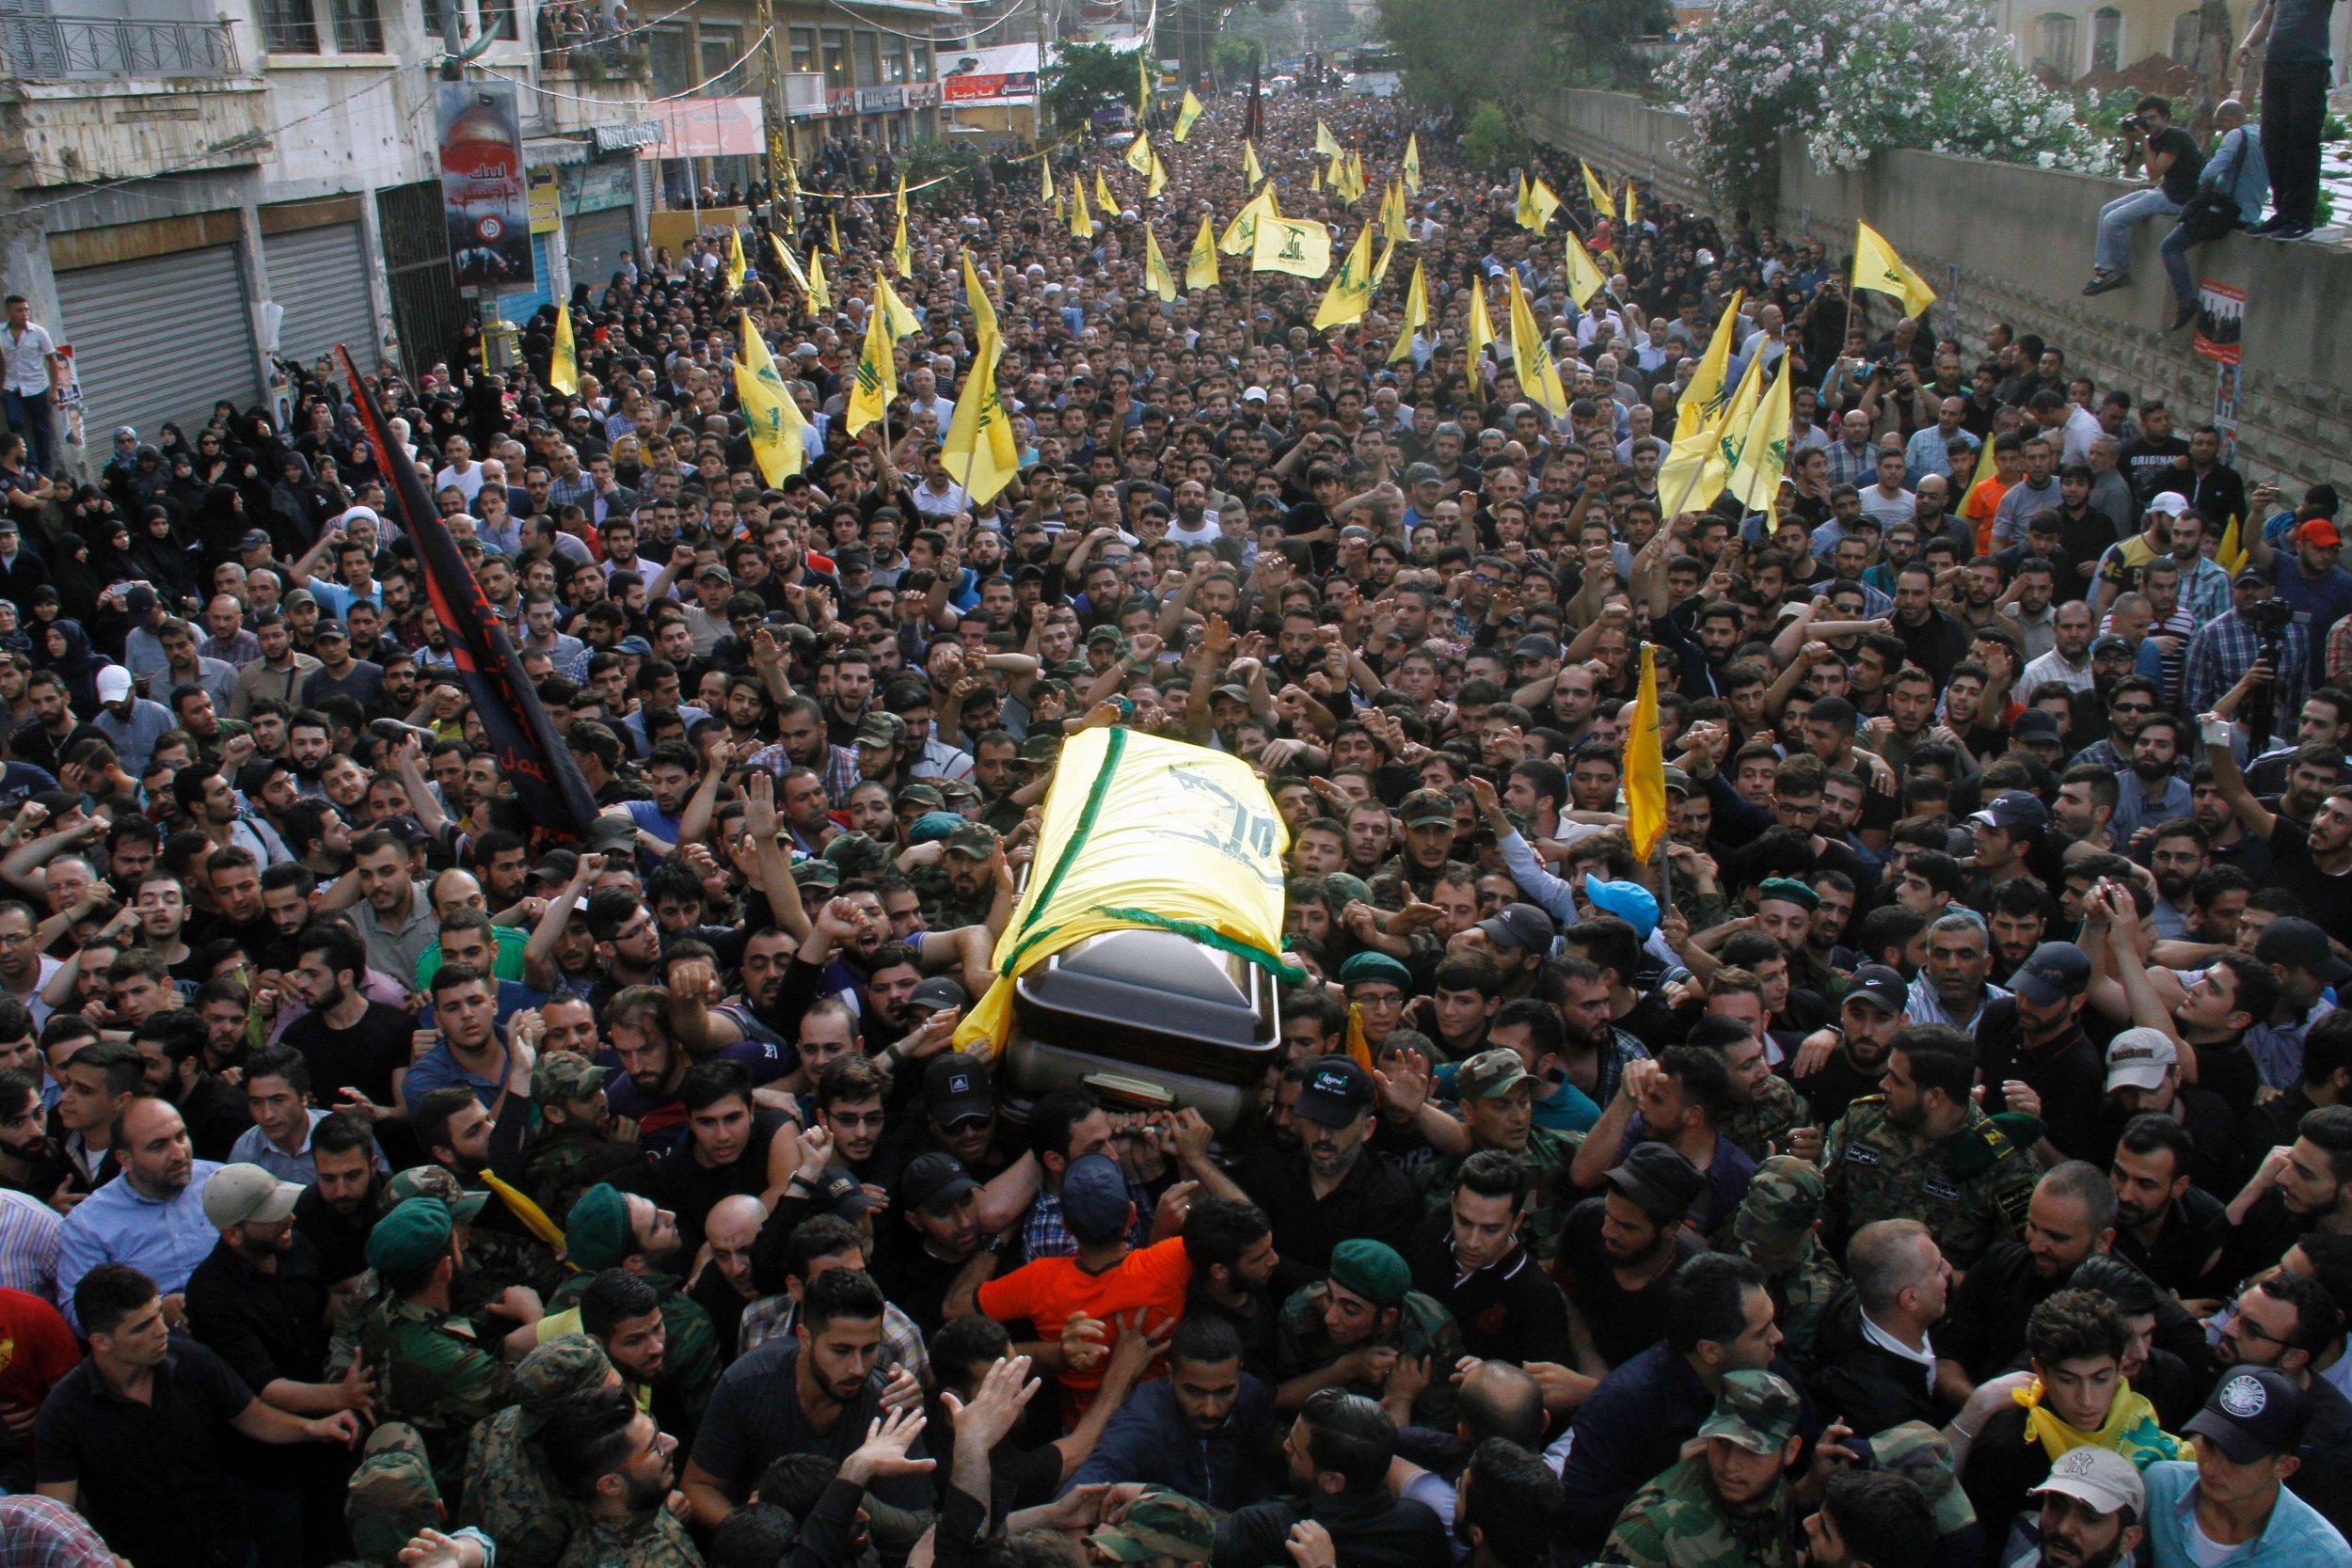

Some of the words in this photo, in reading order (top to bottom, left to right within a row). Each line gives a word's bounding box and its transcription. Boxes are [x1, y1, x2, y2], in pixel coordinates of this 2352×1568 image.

[468, 162, 506, 183] لبيك
[2130, 454, 2177, 467] ORIGINA
[2064, 1452, 2094, 1476] NY
